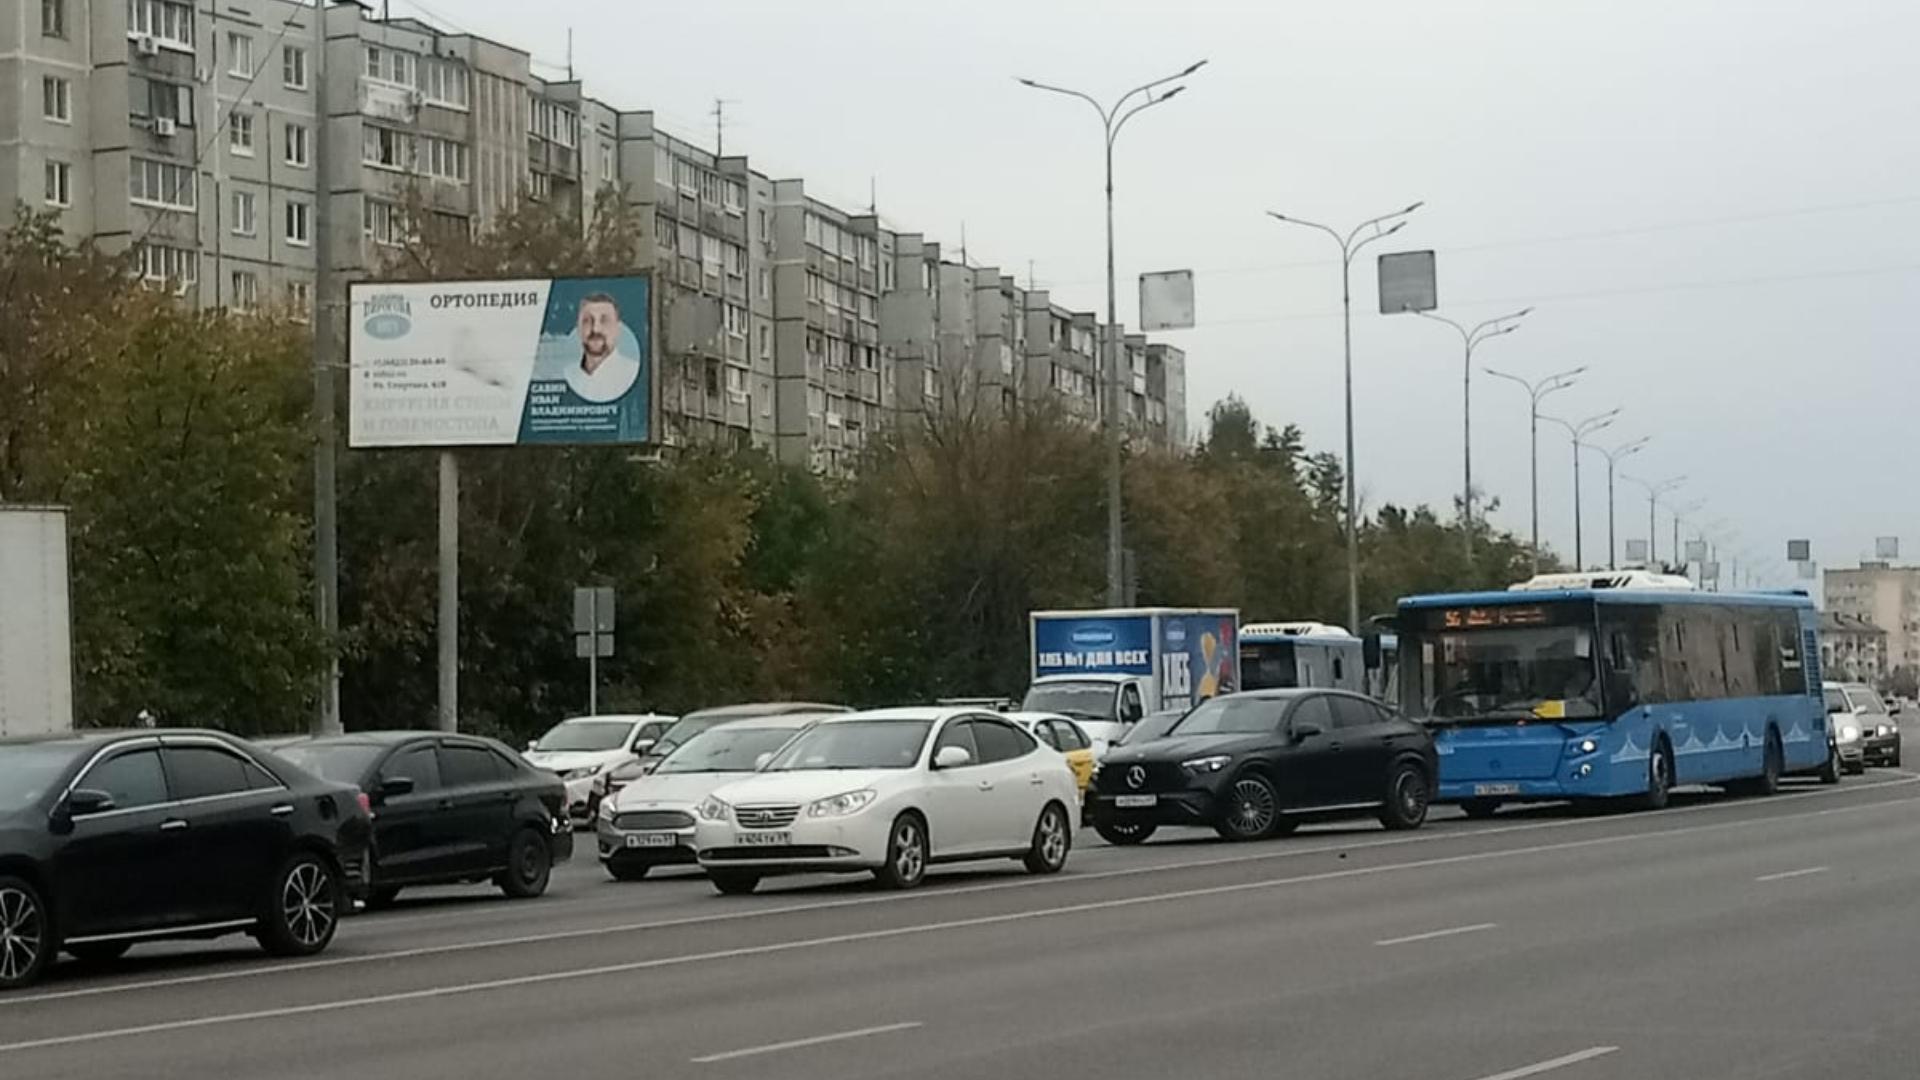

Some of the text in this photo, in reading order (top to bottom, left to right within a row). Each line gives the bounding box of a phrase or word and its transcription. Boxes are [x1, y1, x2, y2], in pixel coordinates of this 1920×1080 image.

[430, 292, 538, 309] ОРТОПЕДИЯ
[531, 395, 561, 405] ИВАН
[531, 405, 618, 416] ВЛАДИМИРОВИЧ
[1039, 653, 1063, 667] ХЛЕБ
[1085, 651, 1113, 668] ДЛЯ
[1115, 650, 1149, 665] ВСЕХ
[1162, 652, 1192, 696] ХЛЕБ
